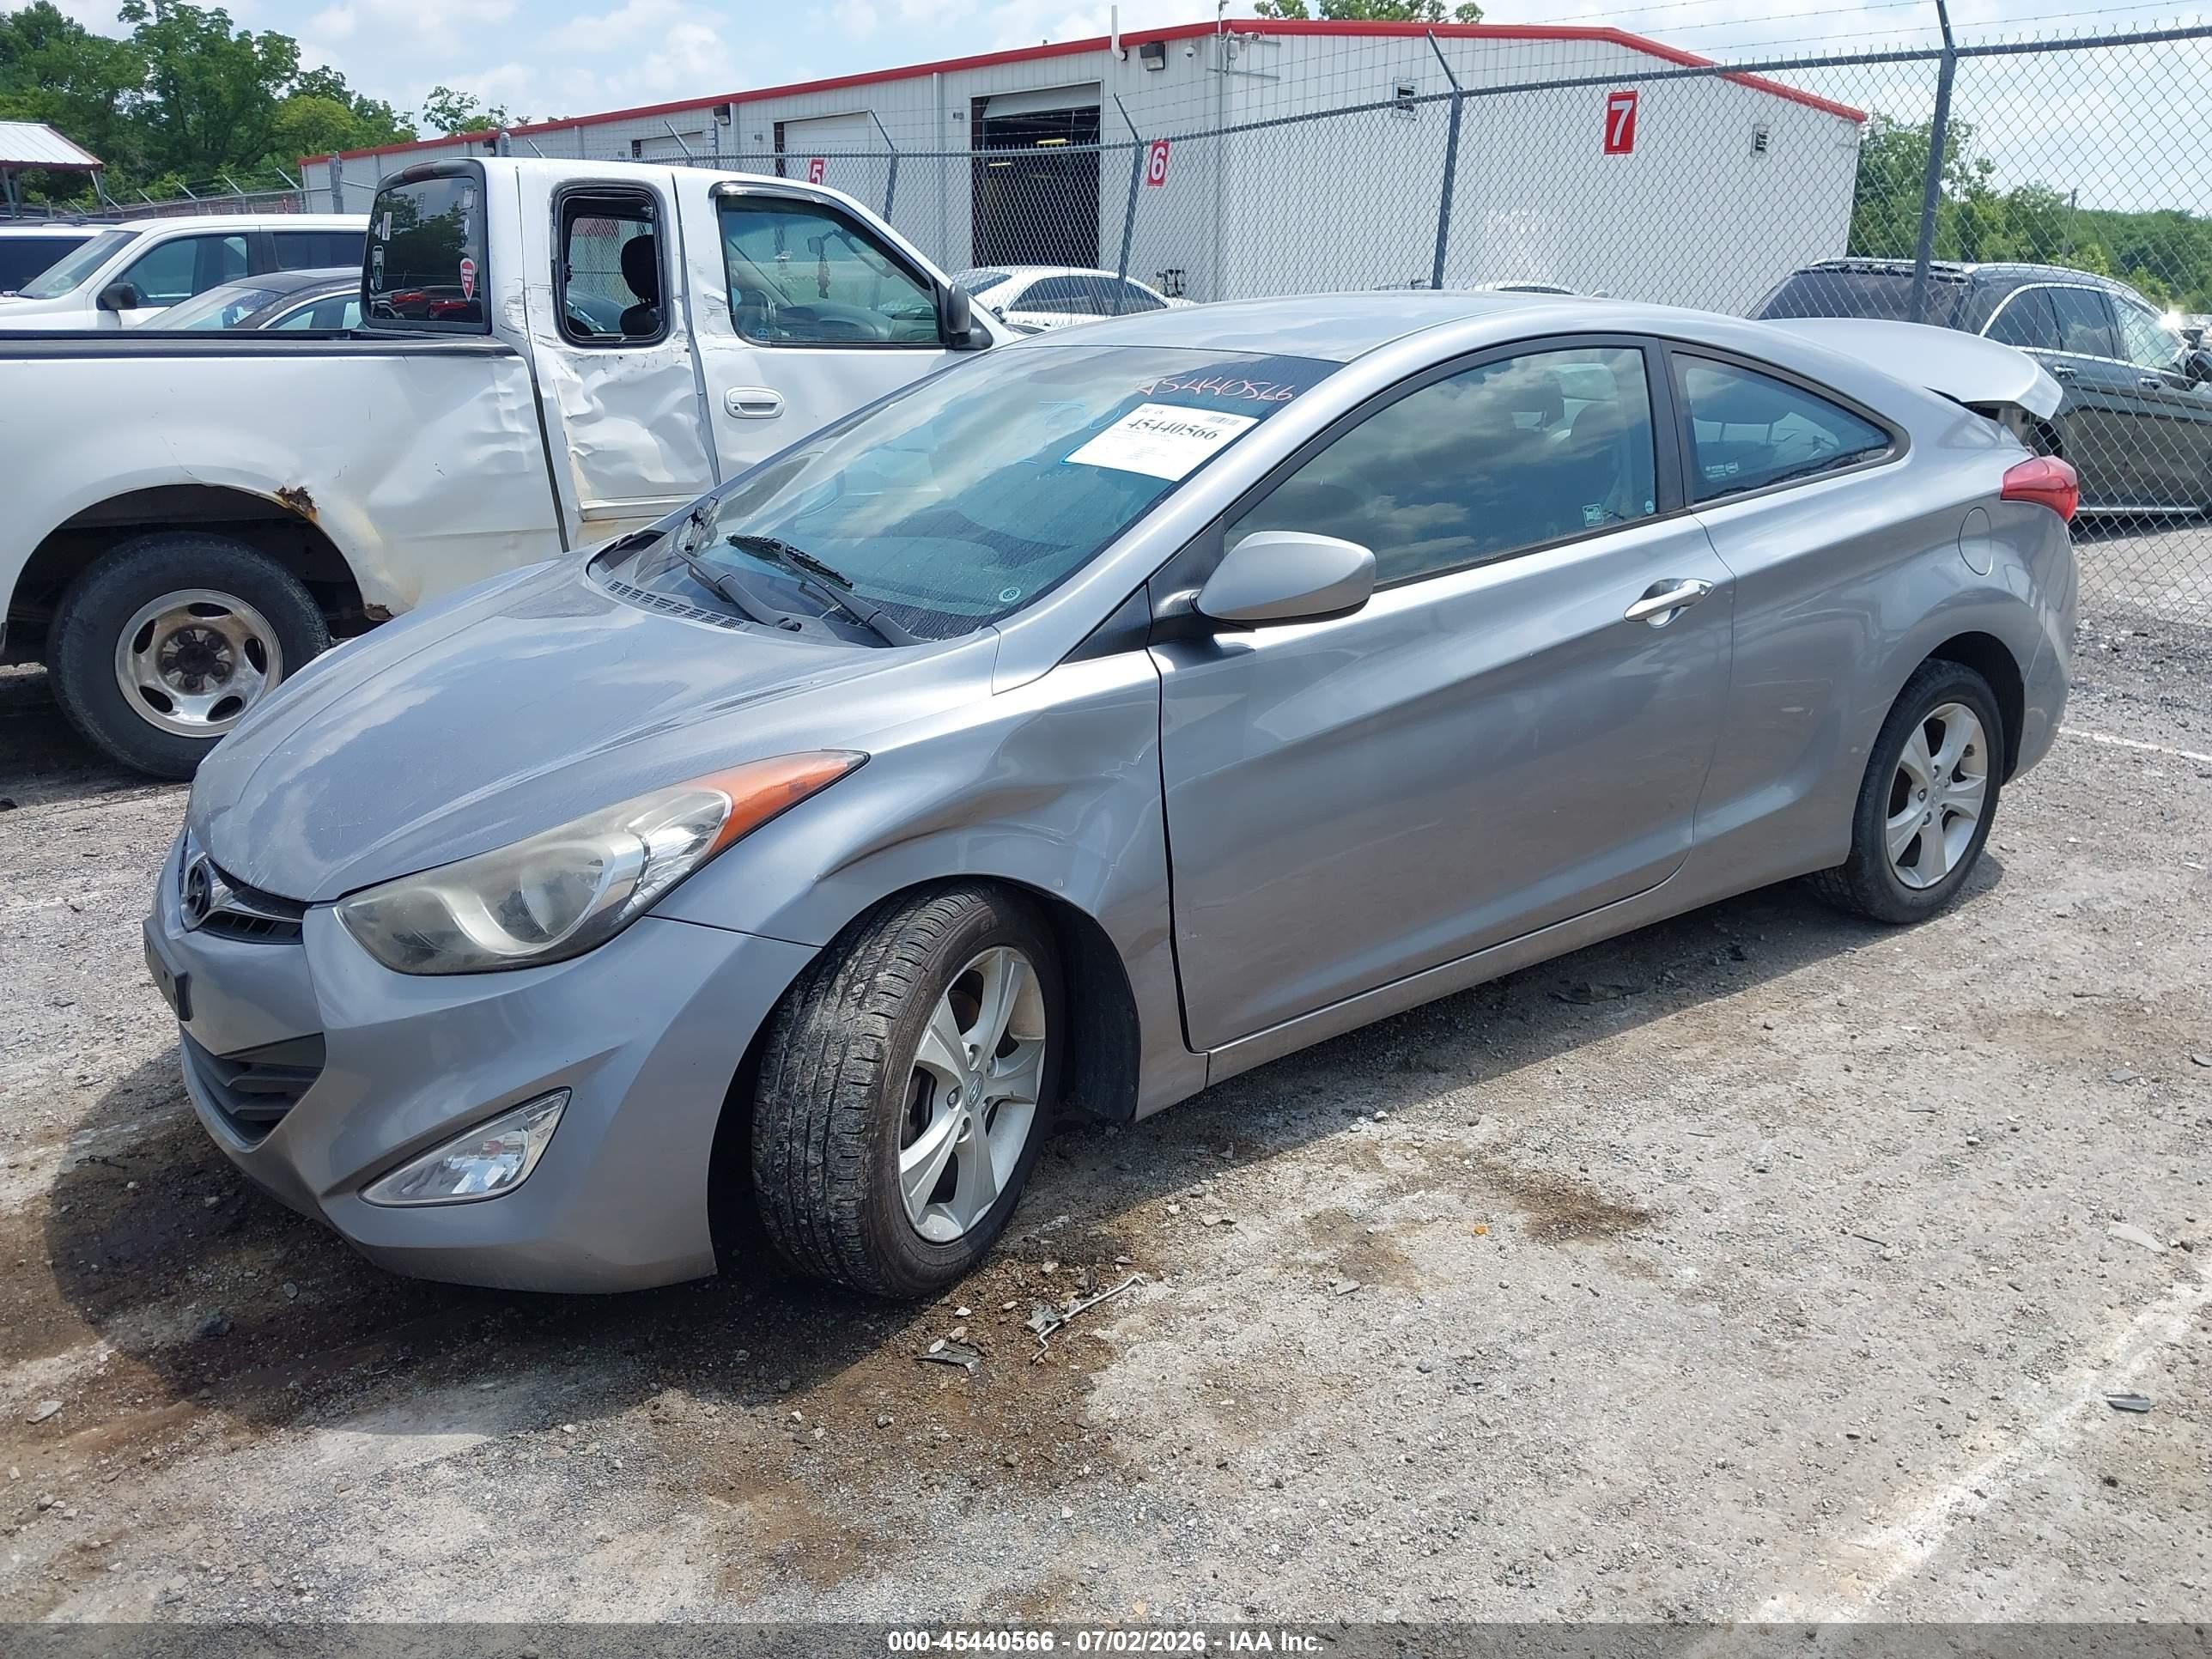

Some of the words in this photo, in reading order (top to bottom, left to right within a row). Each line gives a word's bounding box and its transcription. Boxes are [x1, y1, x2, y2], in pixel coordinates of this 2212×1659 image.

[1611, 100, 1633, 146] 7
[811, 164, 823, 184] 5
[1151, 146, 1165, 180] 6
[1138, 376, 1295, 401] 45440566
[1127, 418, 1218, 441] 45440566
